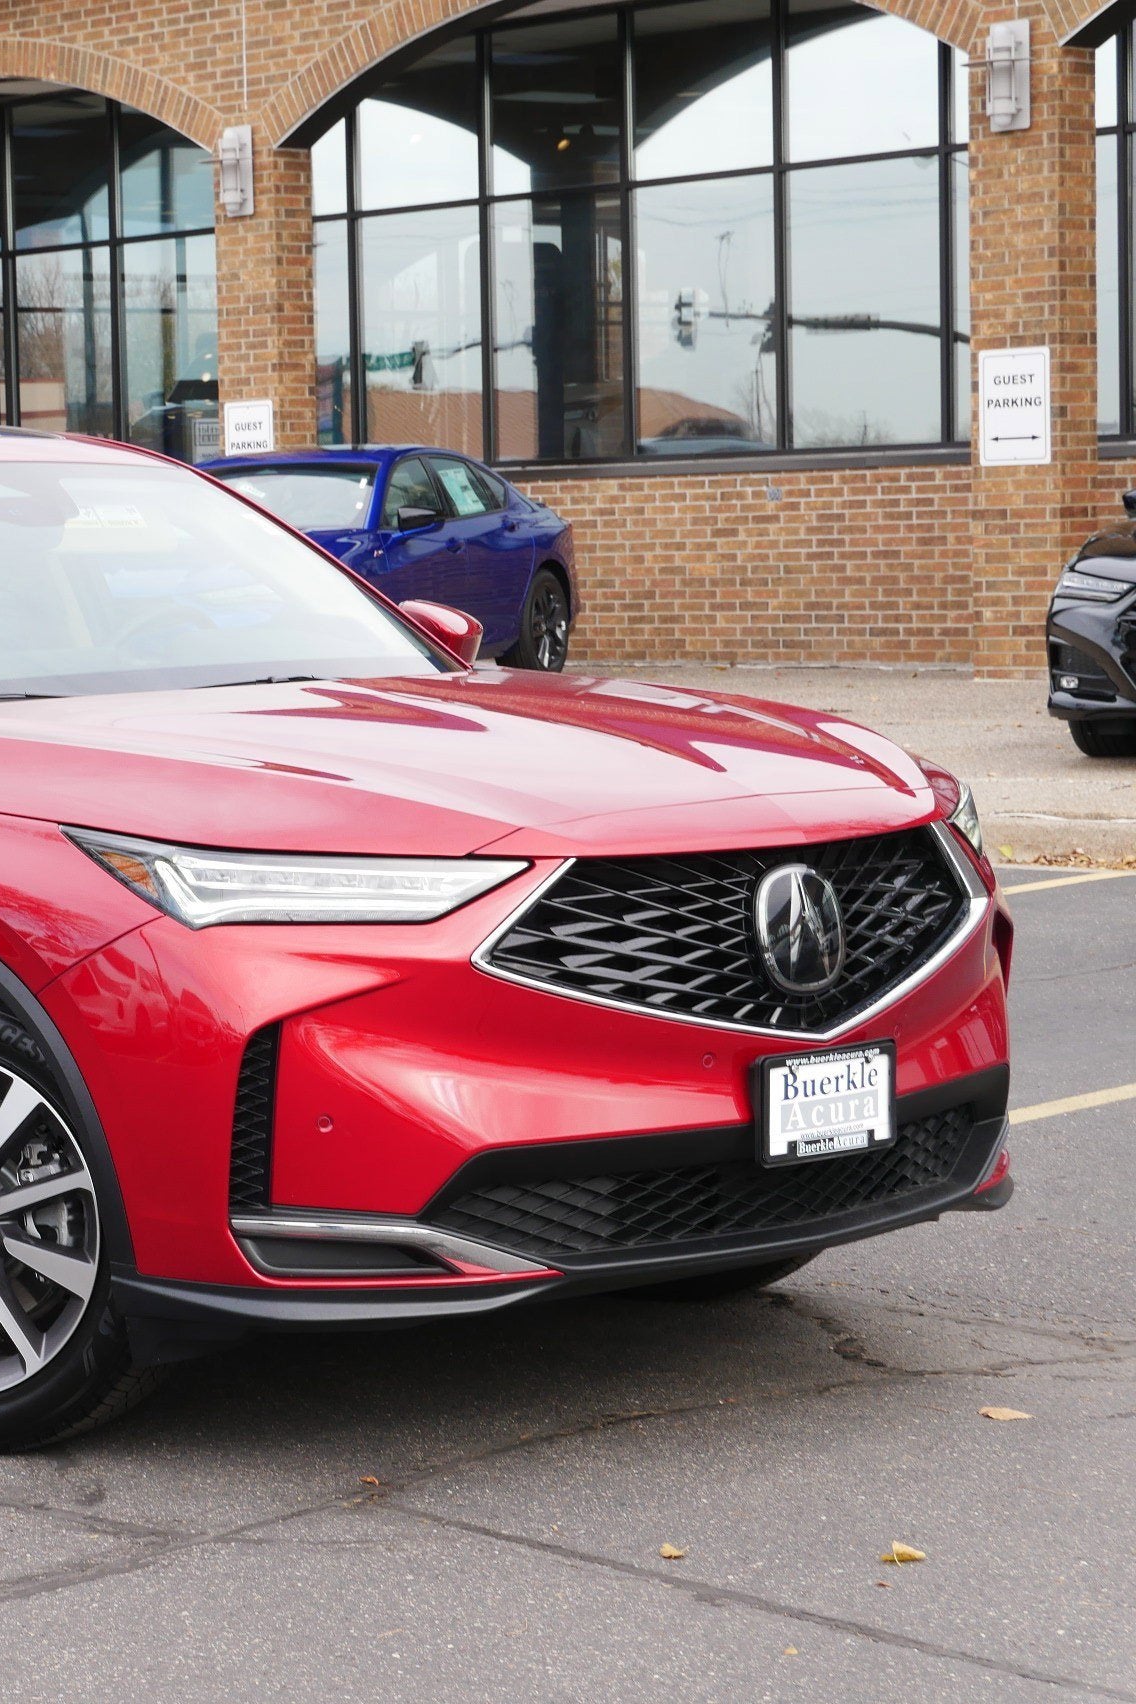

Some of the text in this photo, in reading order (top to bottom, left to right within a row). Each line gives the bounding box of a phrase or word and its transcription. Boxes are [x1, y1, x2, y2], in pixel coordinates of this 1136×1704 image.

[993, 373, 1035, 386] GUEST
[987, 396, 1042, 409] PARKING
[234, 421, 264, 432] GUEST
[230, 440, 268, 450] PARKING
[785, 1047, 880, 1067] www.buerkleacura.com
[781, 1061, 878, 1101] Buerkle
[784, 1095, 876, 1130] Acura
